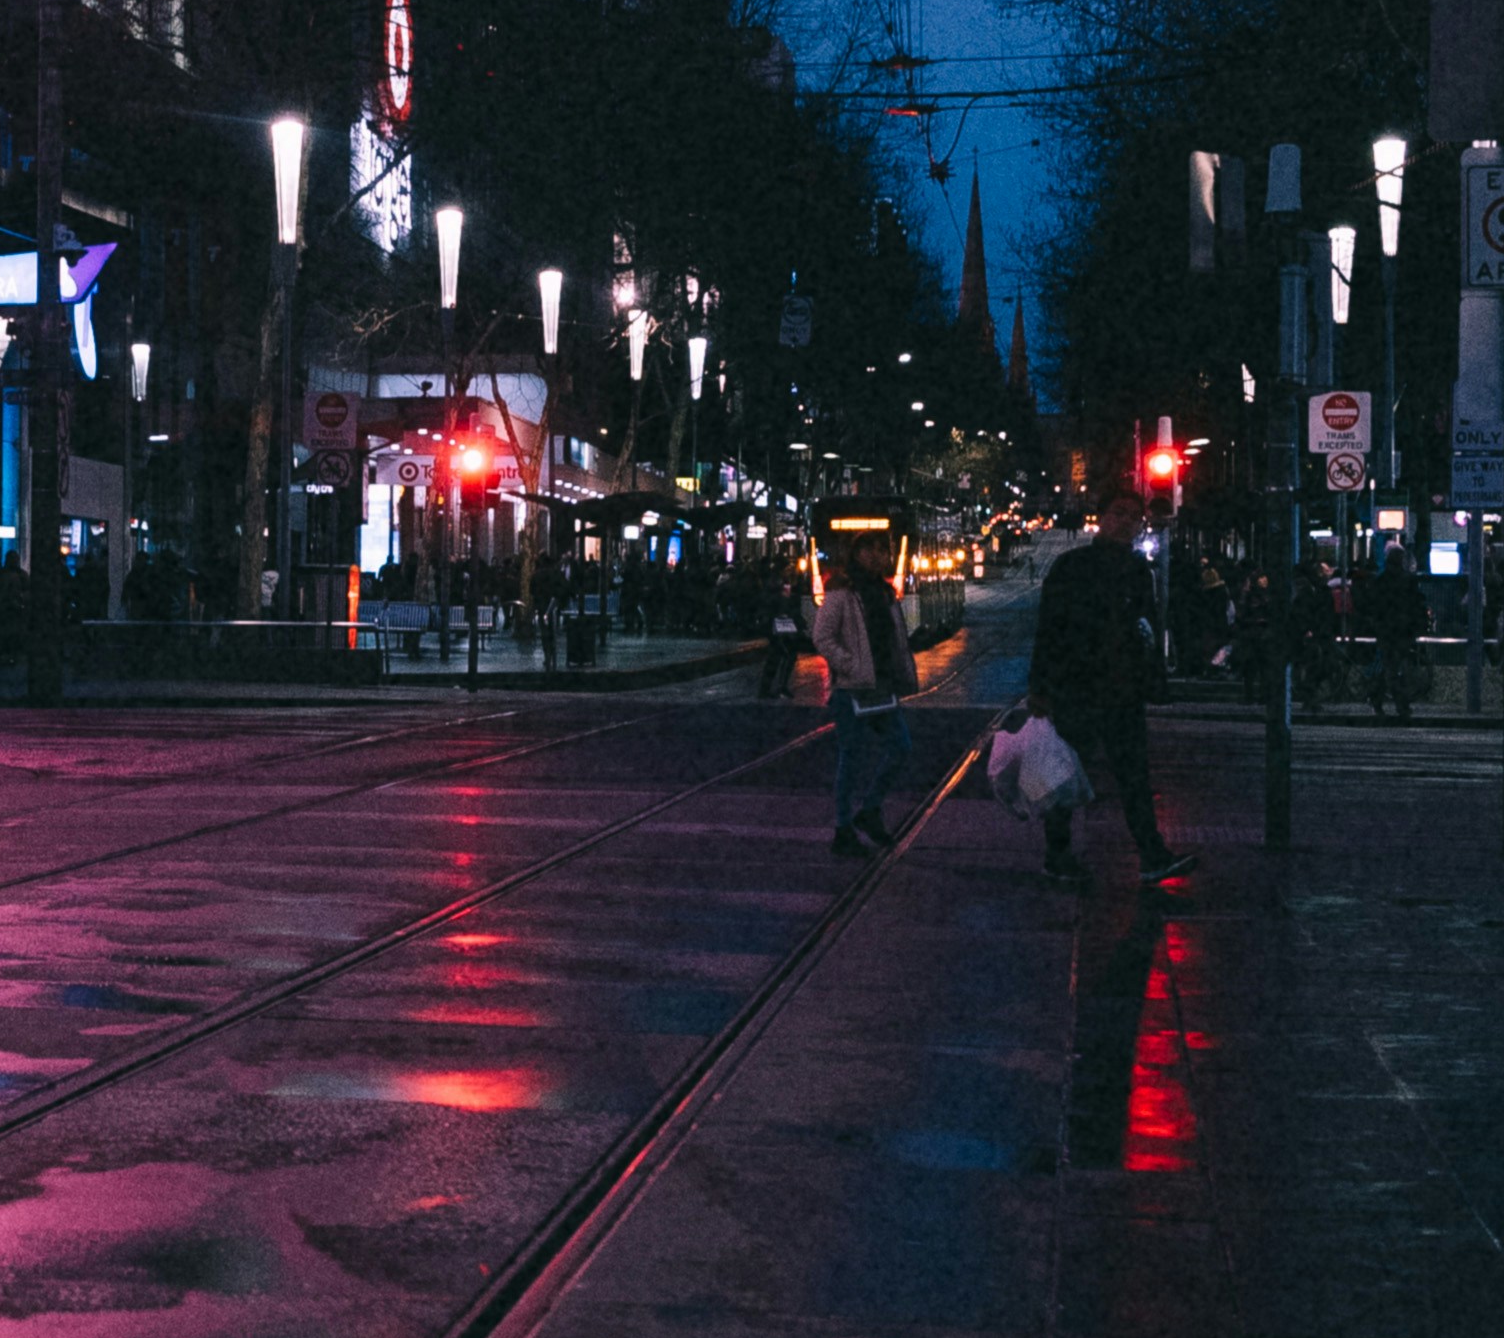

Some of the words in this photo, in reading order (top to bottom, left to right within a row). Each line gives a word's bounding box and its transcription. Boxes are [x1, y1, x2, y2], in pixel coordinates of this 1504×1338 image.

[1326, 431, 1356, 440] TRAMS
[1455, 430, 1502, 445] ONLY
[1318, 441, 1363, 450] EXCEPTED
